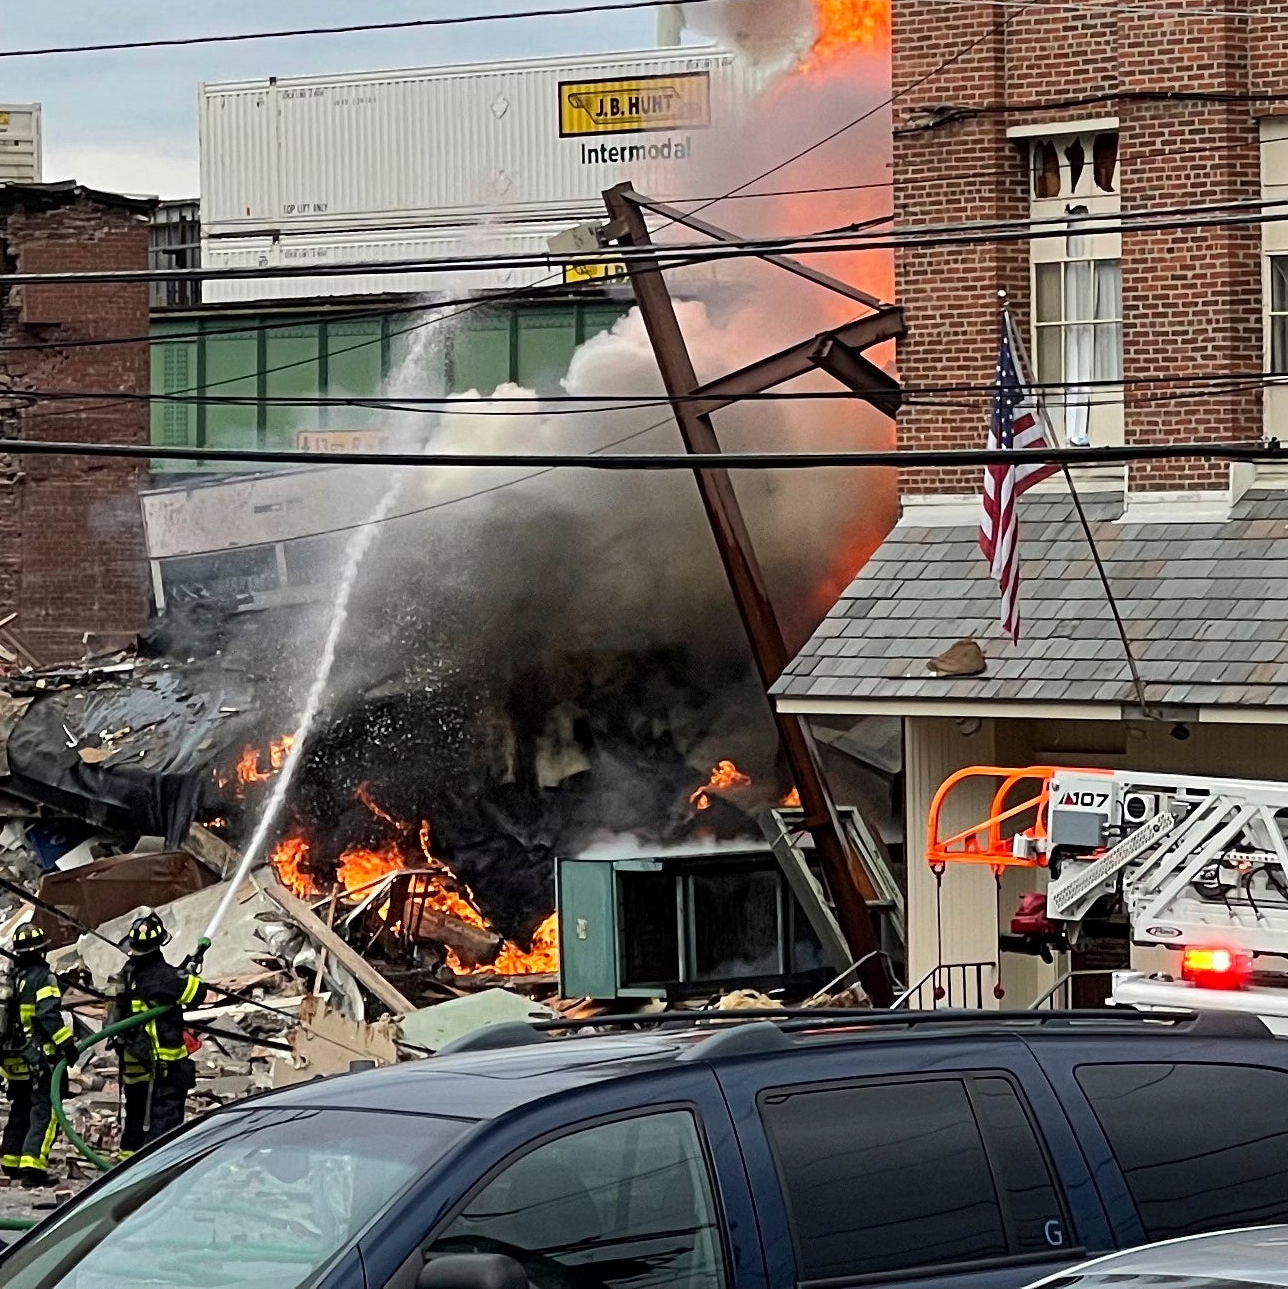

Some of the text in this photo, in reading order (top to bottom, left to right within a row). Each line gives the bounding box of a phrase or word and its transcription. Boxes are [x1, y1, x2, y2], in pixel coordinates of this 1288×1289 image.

[595, 94, 674, 118] J.B. HUNT
[581, 136, 691, 164] Intermodal
[1044, 1219, 1063, 1246] G
